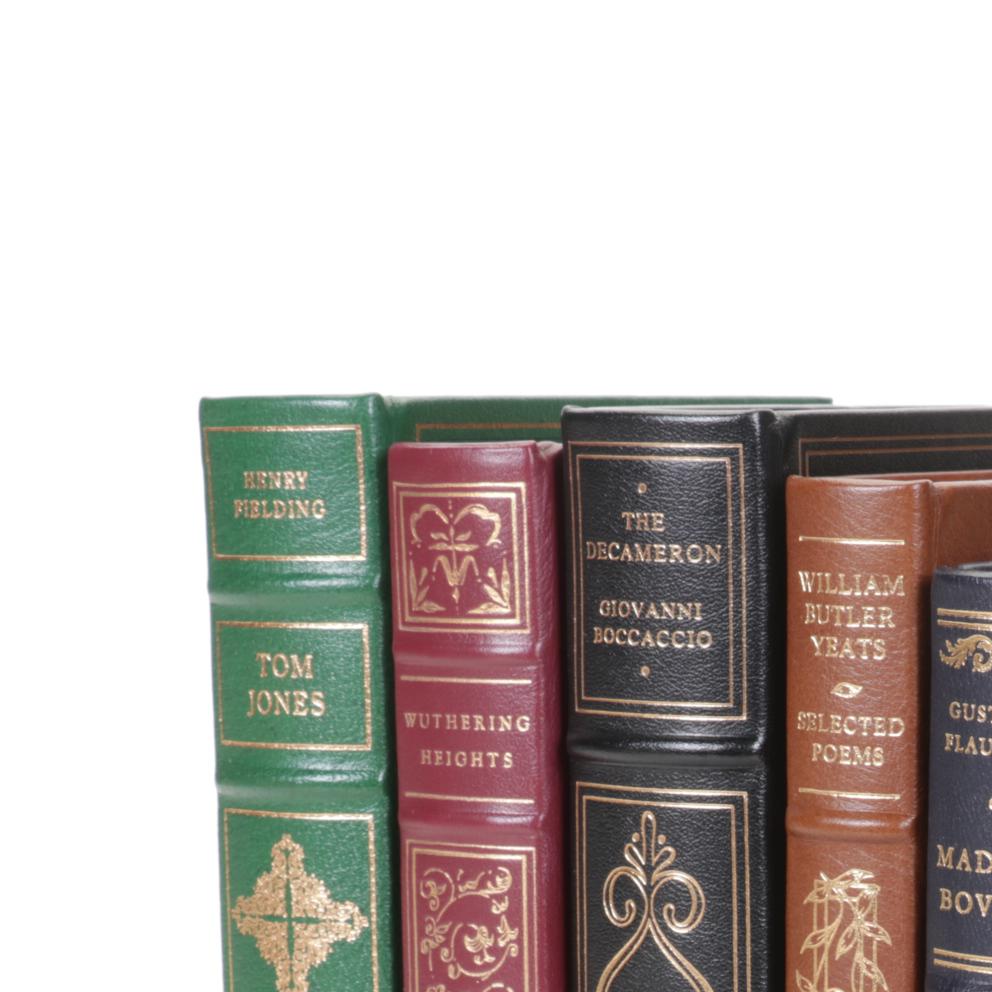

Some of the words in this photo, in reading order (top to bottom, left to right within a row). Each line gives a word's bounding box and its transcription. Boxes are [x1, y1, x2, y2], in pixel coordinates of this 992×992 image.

[243, 471, 308, 491] HENRY
[233, 500, 326, 519] FIELDING
[622, 512, 665, 532] THE
[586, 541, 721, 564] DECAMERON
[799, 571, 905, 598] WILLIAM
[600, 600, 702, 622] GIOVANNI
[805, 603, 895, 629] BUTLER
[593, 628, 713, 649] BOCCACCIO
[810, 635, 886, 660] YEATS
[256, 653, 315, 679] TOM
[247, 690, 325, 717] JONES
[404, 712, 531, 733] WUTHERING
[797, 711, 904, 737] SELECTED
[420, 749, 513, 768] HEIGHTS
[811, 743, 883, 767] POEMS
